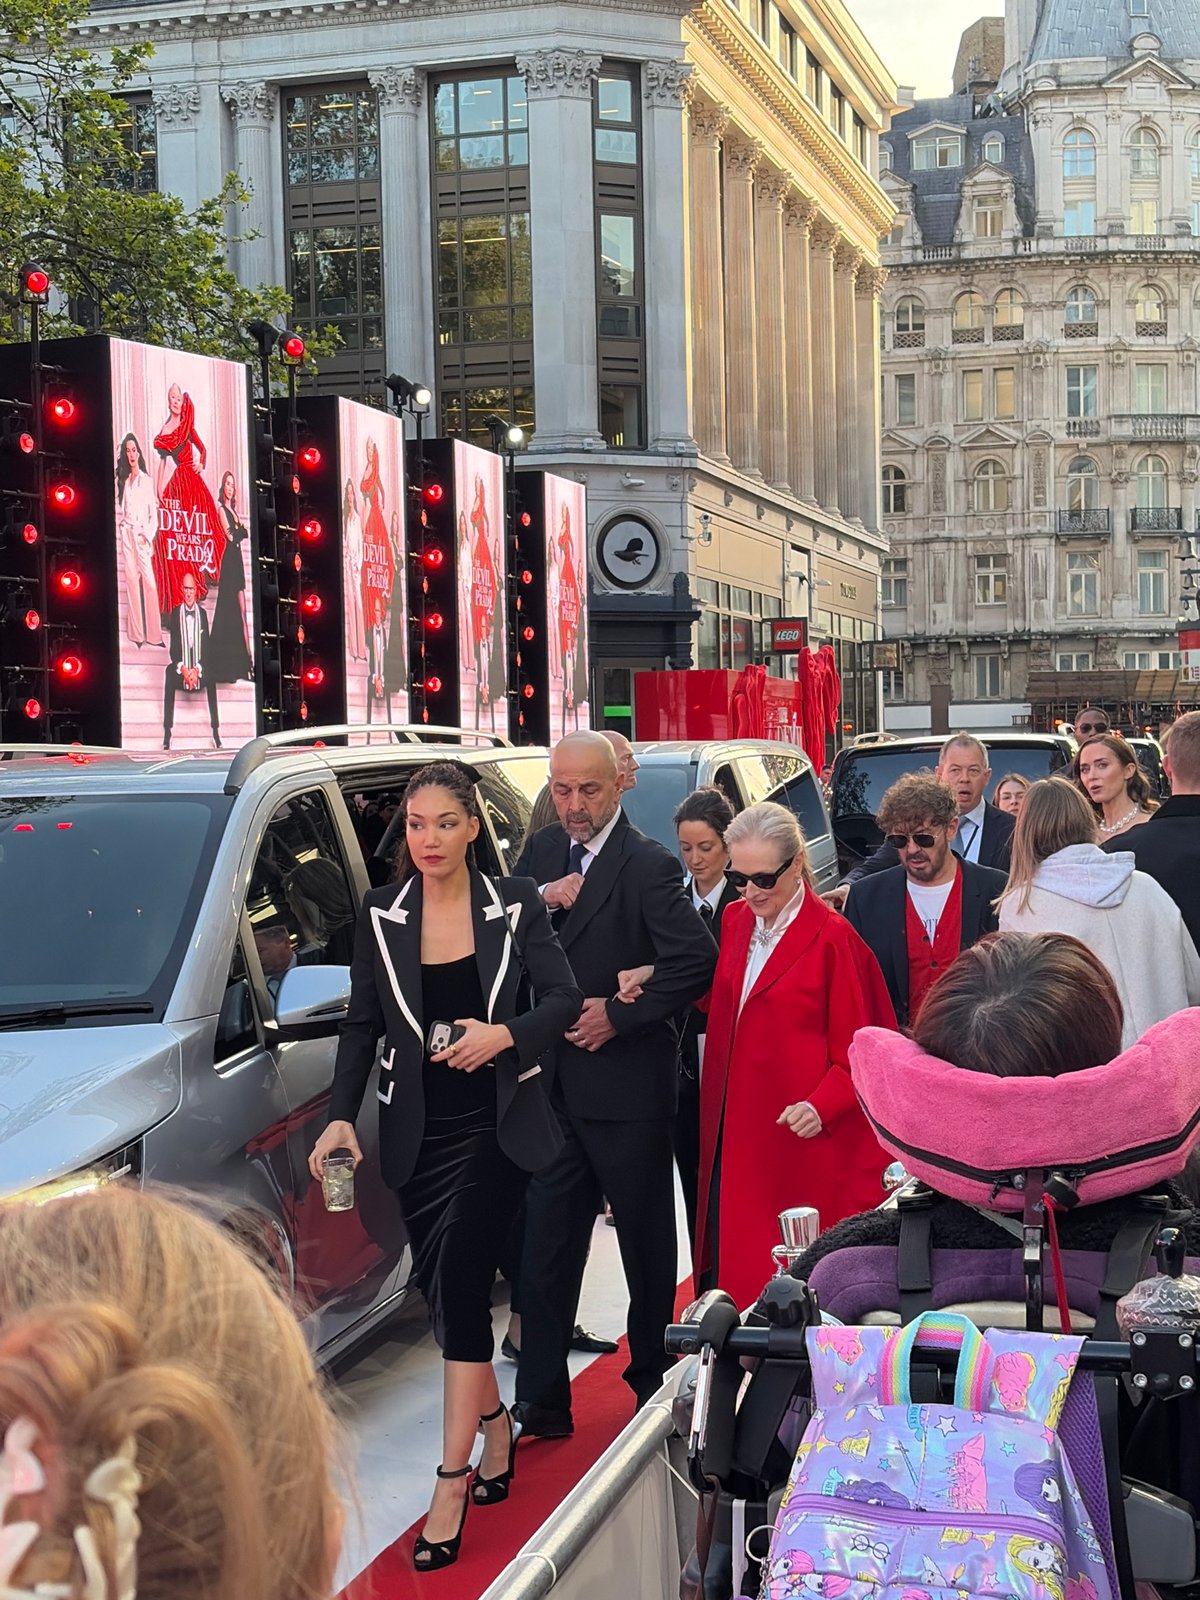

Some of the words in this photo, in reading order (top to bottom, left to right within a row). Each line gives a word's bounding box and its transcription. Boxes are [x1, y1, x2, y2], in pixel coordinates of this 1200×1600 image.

[163, 498, 181, 509] THE
[159, 505, 213, 535] DEVIL
[175, 533, 202, 546] WEARS
[363, 540, 388, 565] DEVIL
[775, 630, 799, 641] LEGO
